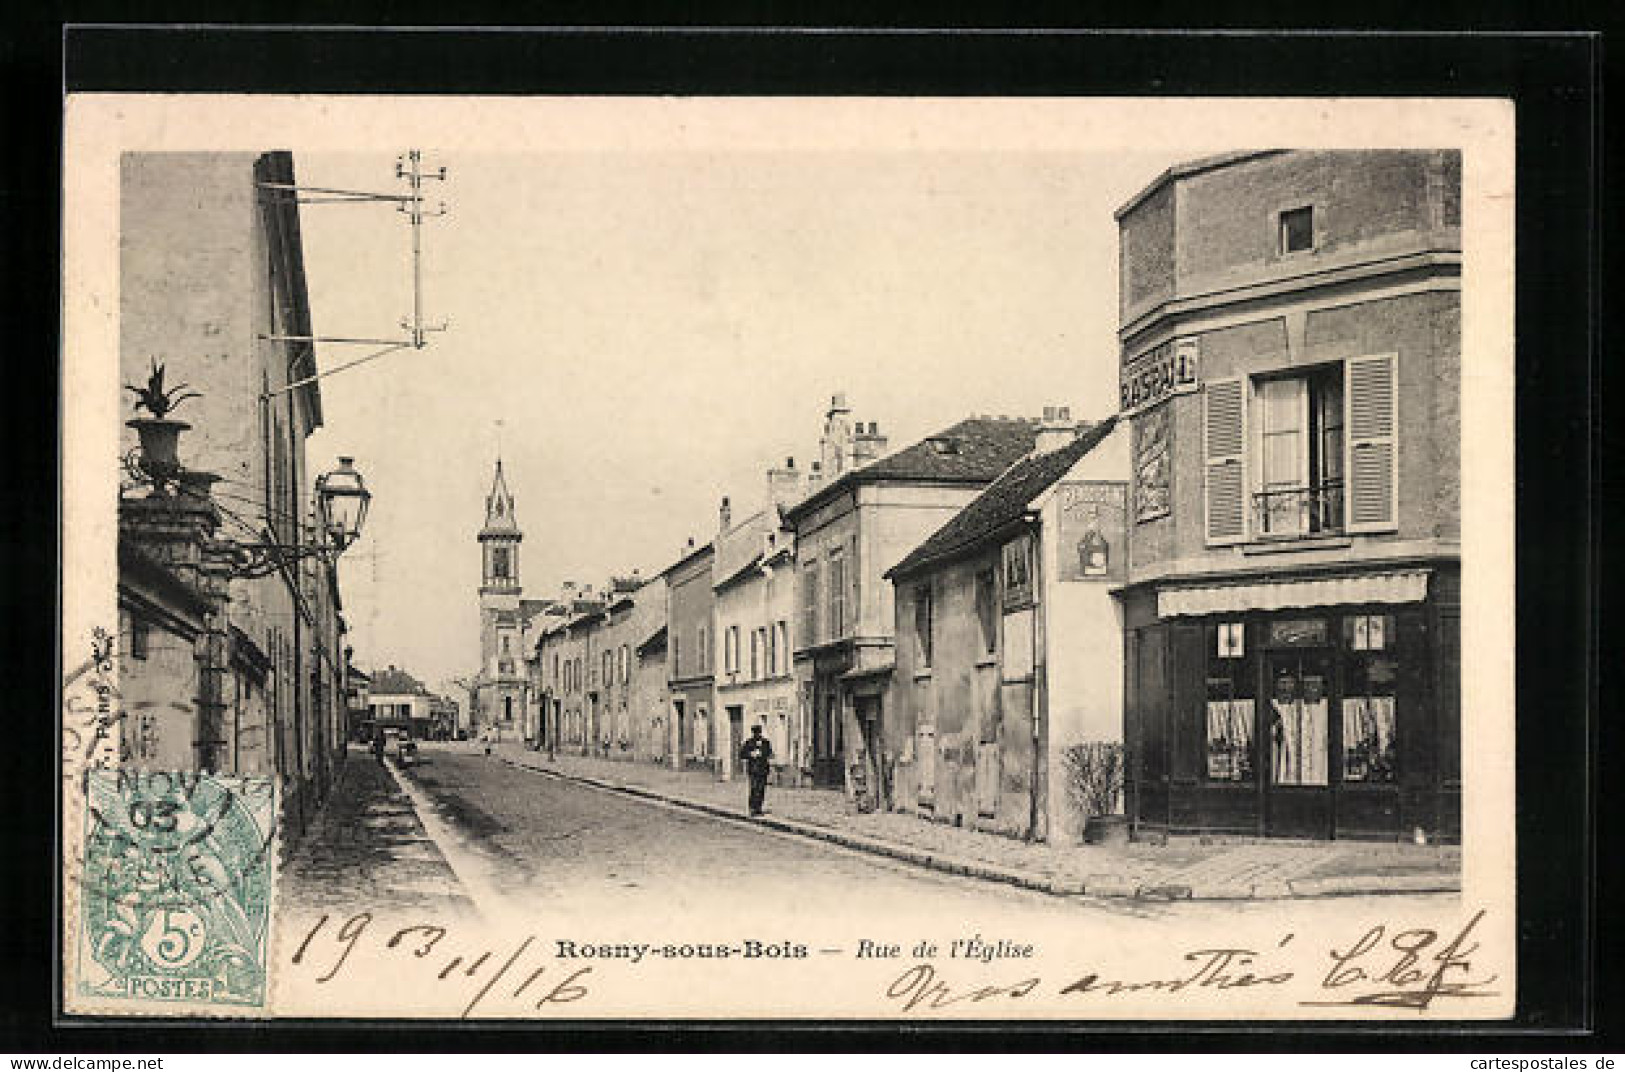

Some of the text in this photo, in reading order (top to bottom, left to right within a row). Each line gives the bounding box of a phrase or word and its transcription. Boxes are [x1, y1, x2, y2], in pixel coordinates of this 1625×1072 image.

[555, 934, 1035, 964] Rosny-sous-Bois Rue de l'Église
[131, 979, 210, 997] POSTES
